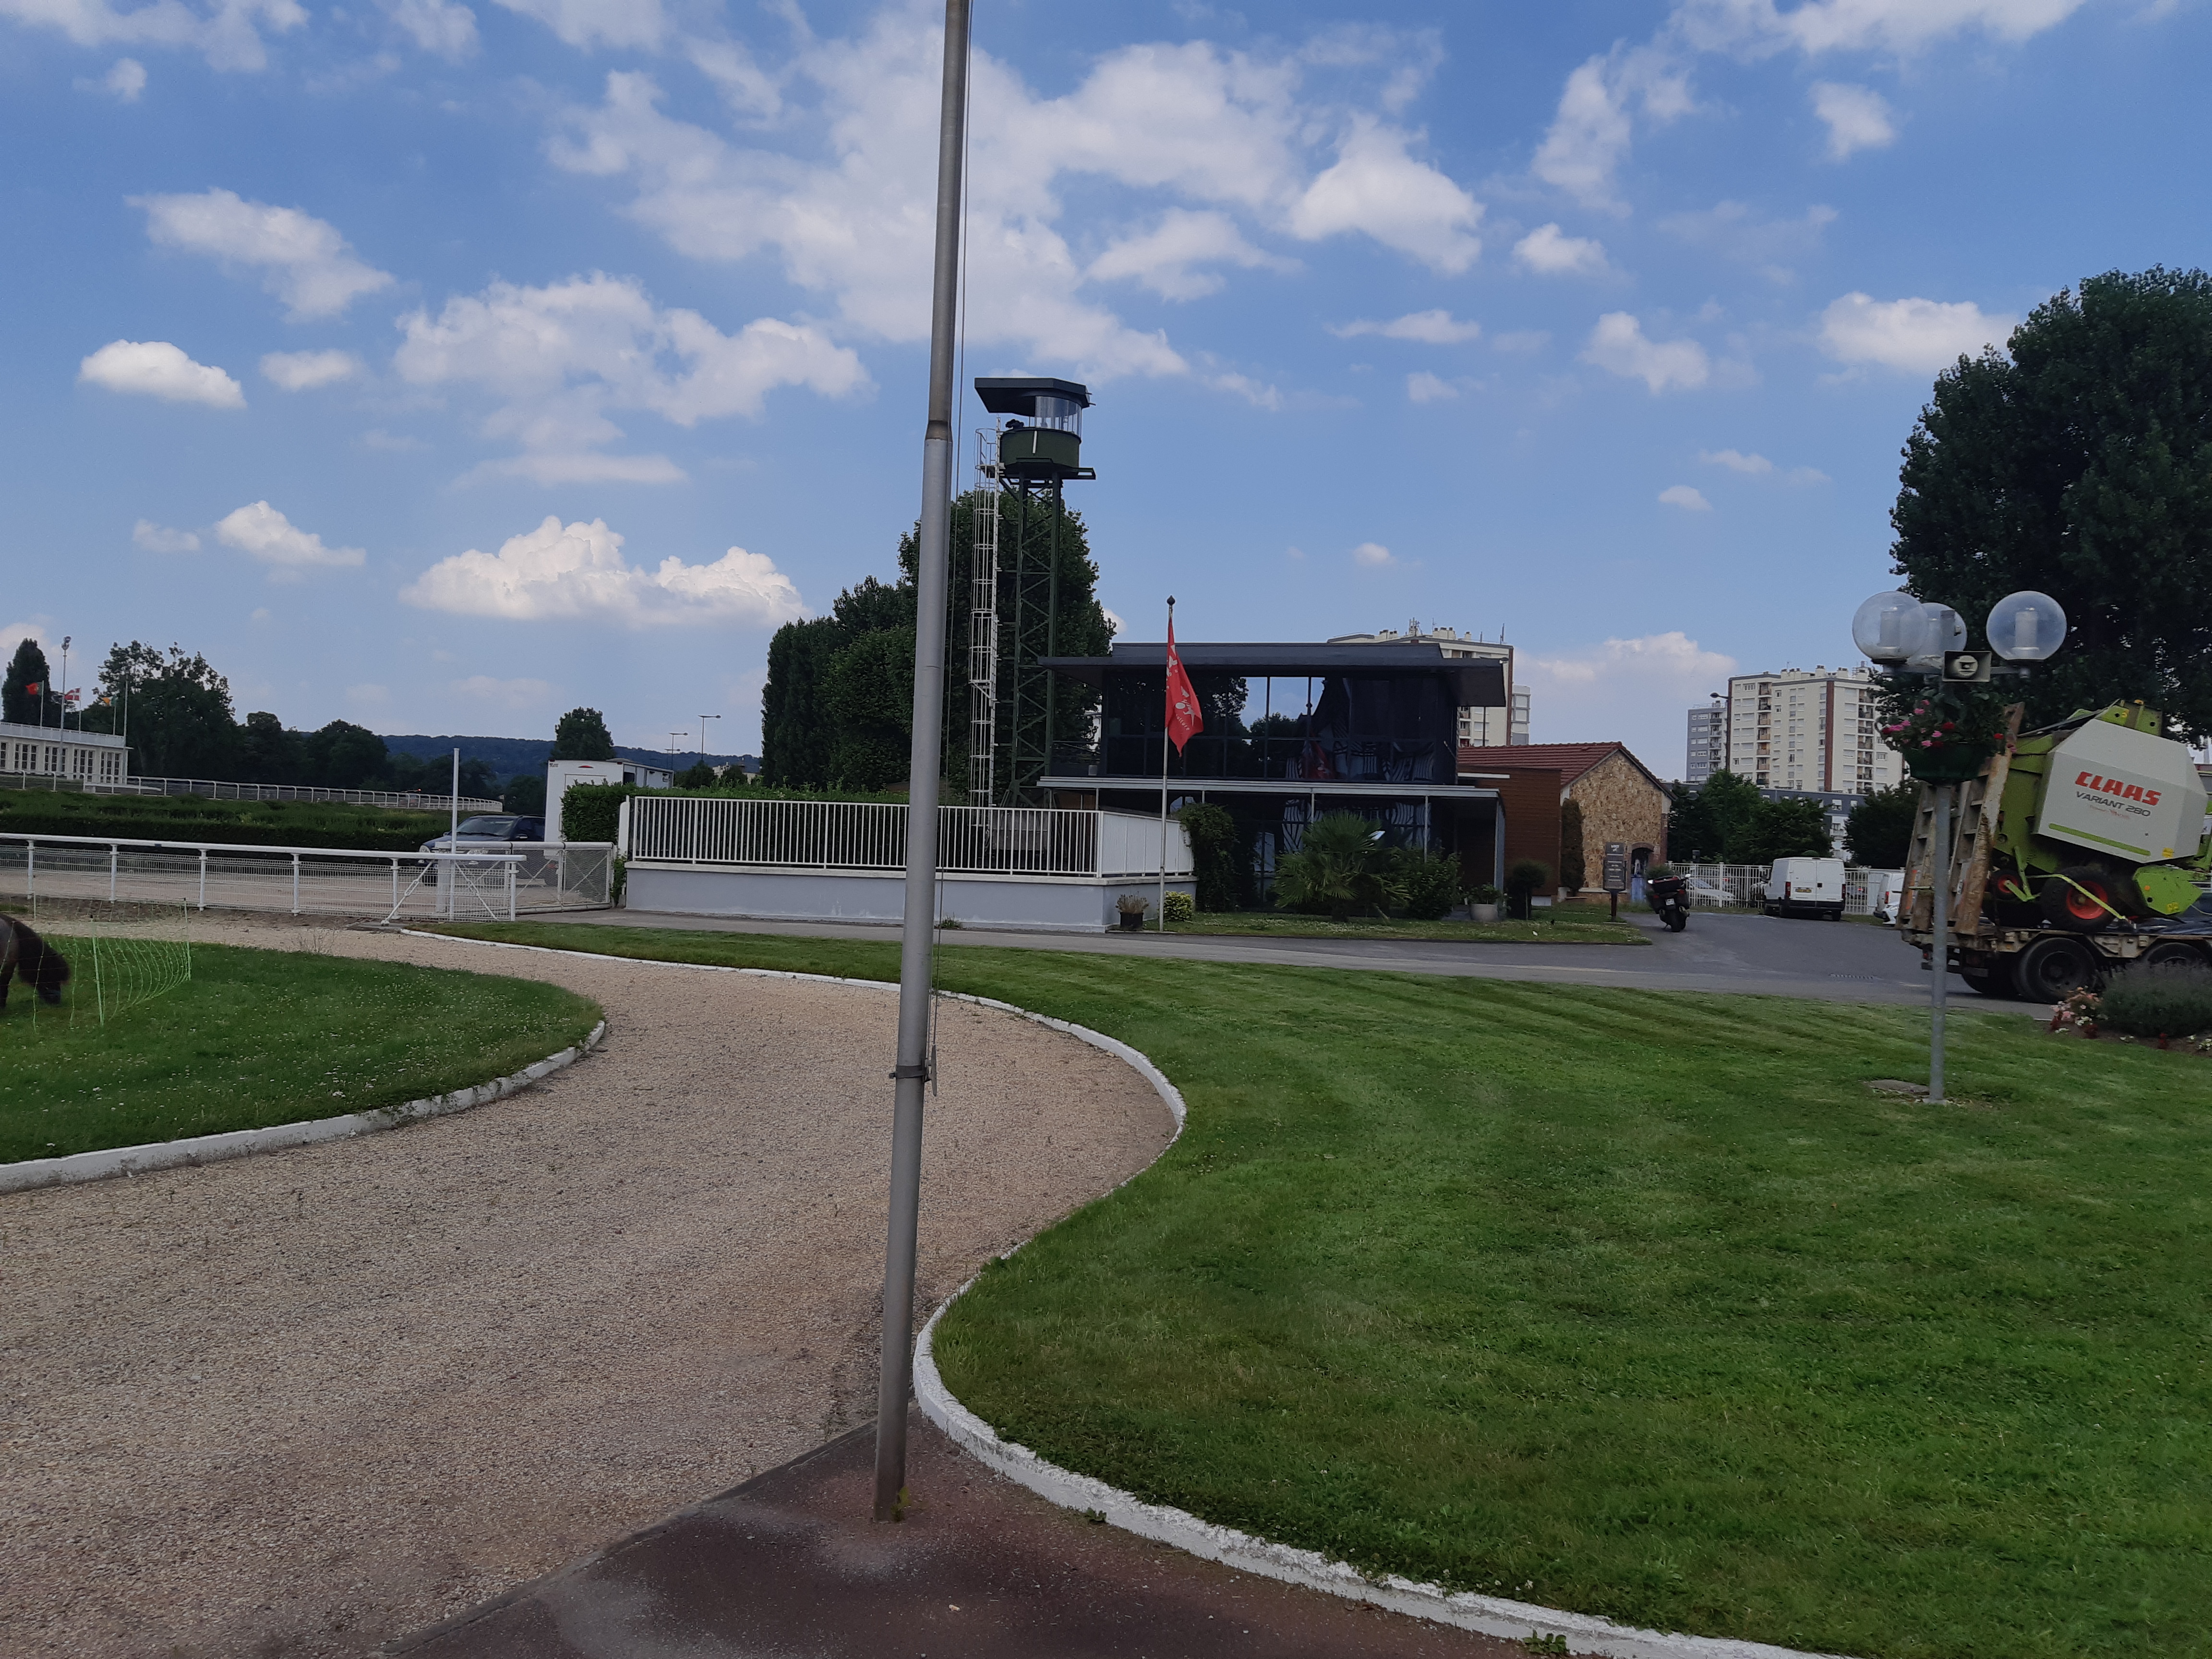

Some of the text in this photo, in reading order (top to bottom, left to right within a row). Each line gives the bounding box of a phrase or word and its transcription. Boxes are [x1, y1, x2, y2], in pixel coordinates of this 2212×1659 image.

[2075, 771, 2162, 806] CLAAS
[2076, 791, 2125, 809] VARIANT
[2126, 805, 2151, 817] 280
